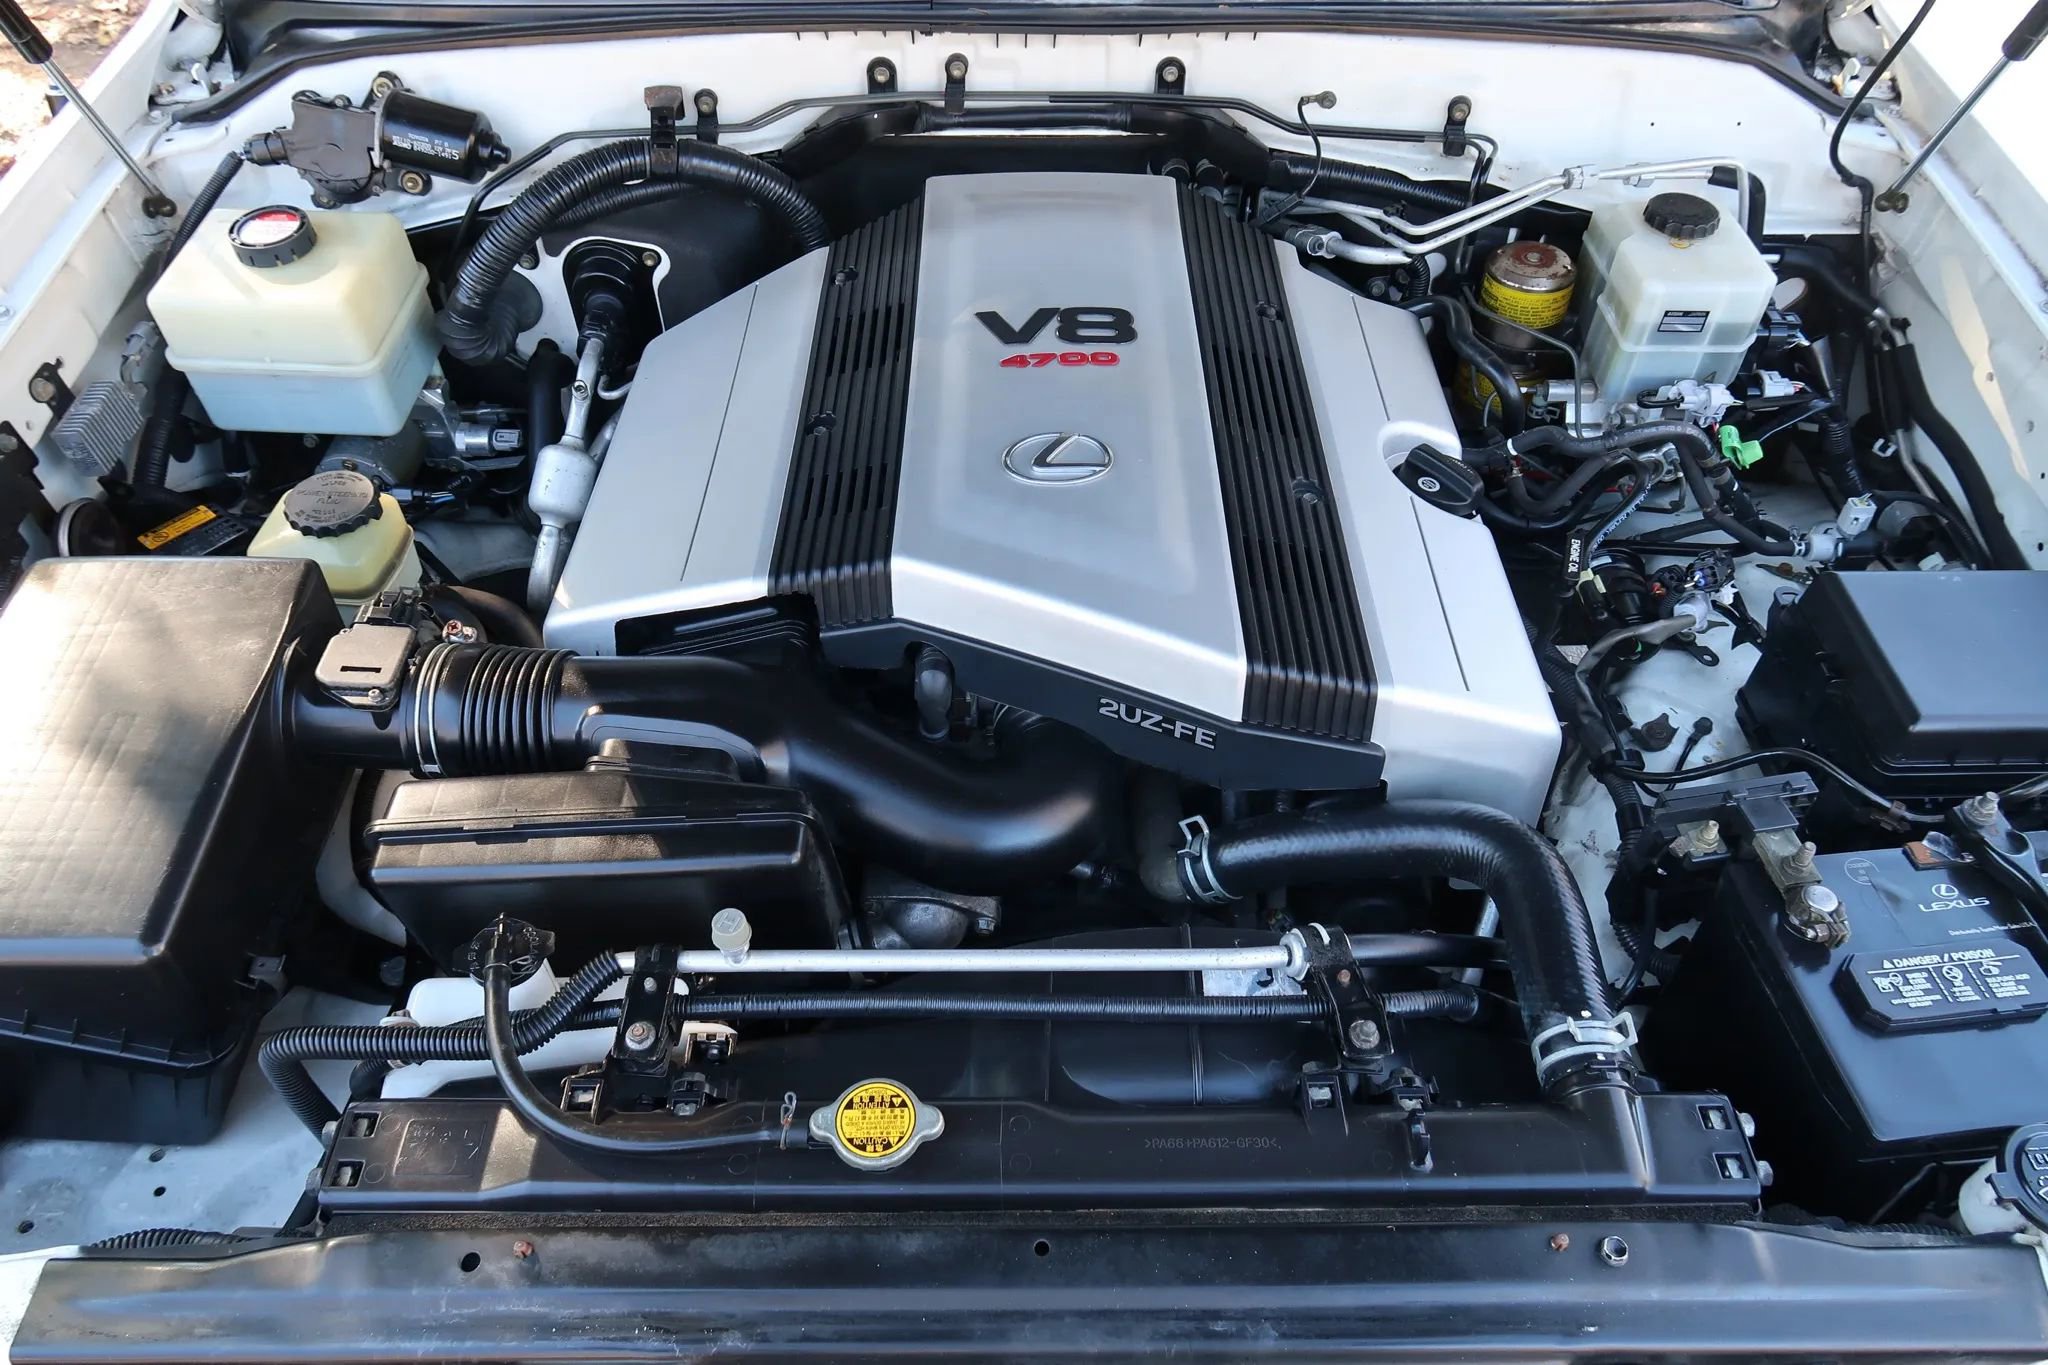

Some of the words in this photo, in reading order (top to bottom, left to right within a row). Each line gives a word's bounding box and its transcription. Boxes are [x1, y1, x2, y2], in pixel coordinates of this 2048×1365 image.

[976, 307, 1137, 344] V8
[999, 352, 1120, 368] 4700
[1569, 538, 1581, 562] ENGINE
[1568, 562, 1579, 573] OIL
[1098, 697, 1217, 750] 2UZ-FE
[1918, 897, 1990, 912] LEXUS
[1893, 955, 1942, 968] DANGER
[1951, 949, 1996, 961] POISON
[853, 1137, 888, 1145] CAUTION
